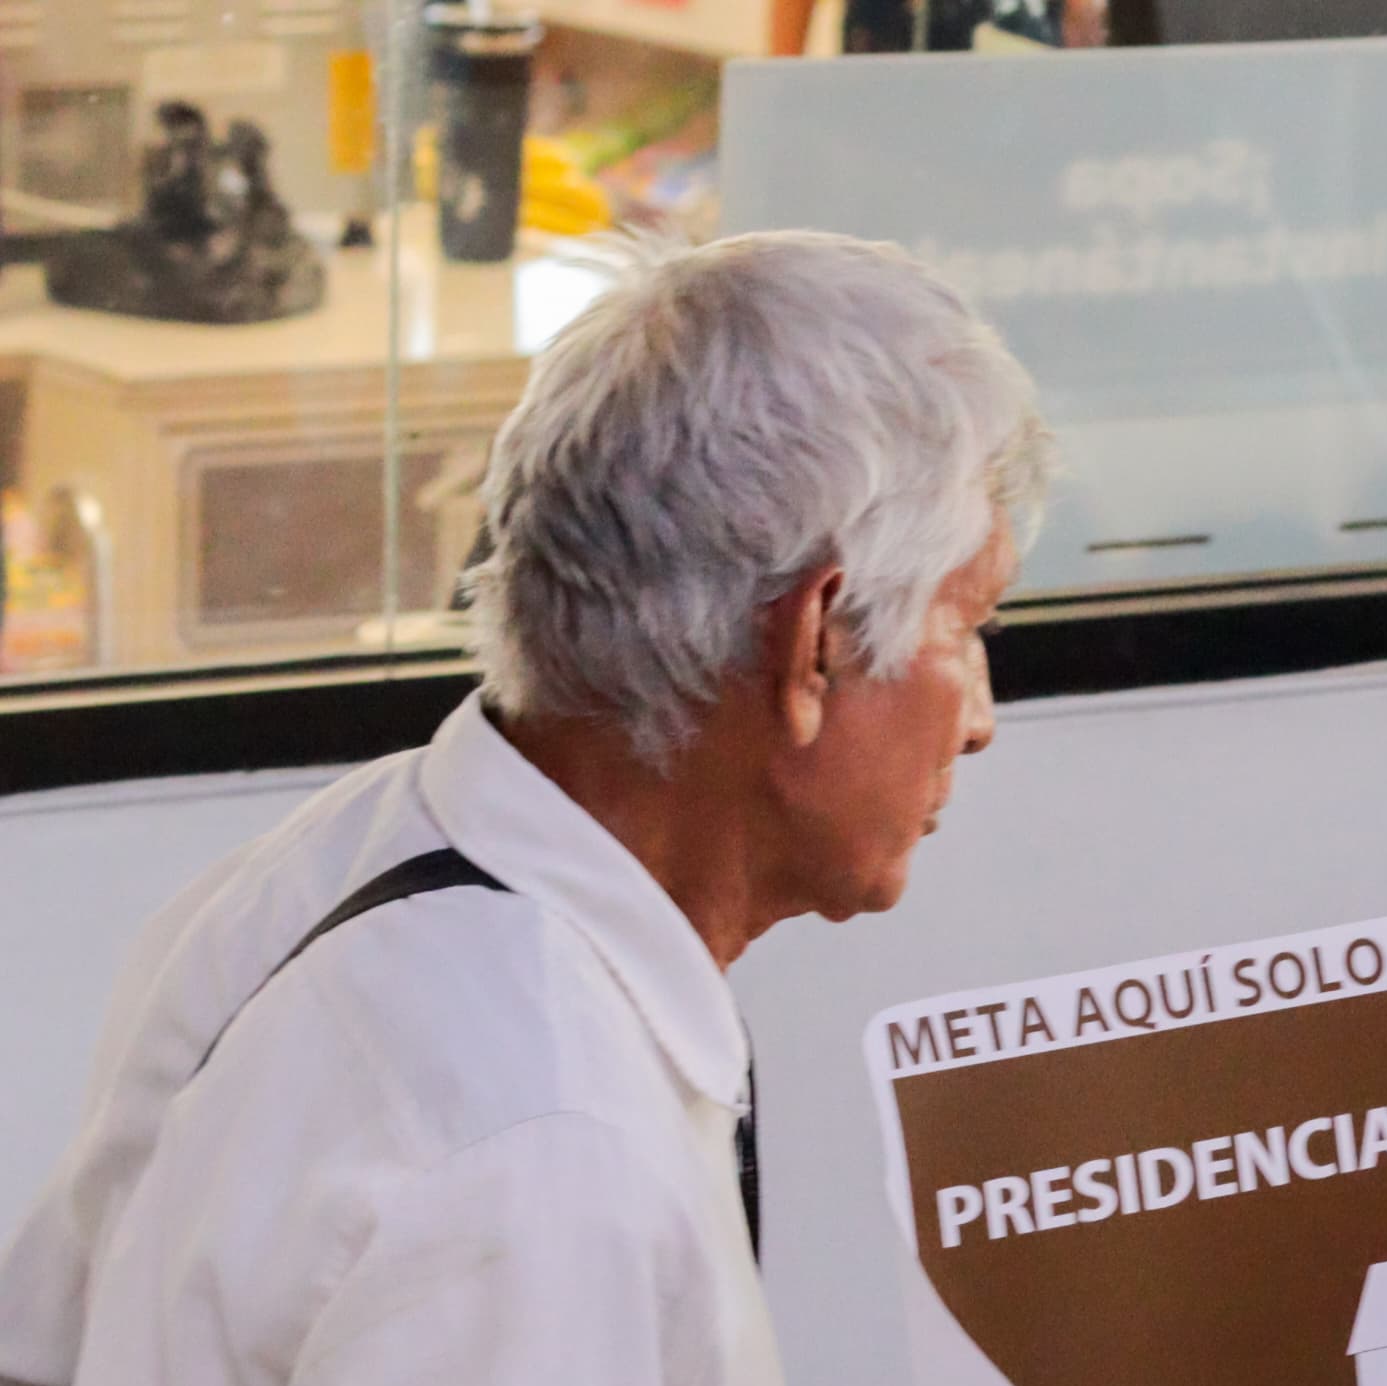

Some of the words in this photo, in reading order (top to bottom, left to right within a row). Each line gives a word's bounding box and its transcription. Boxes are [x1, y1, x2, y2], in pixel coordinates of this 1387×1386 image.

[886, 996, 1056, 1070] META
[1073, 955, 1217, 1038] AQUÍ
[1233, 937, 1383, 1008] SOLO
